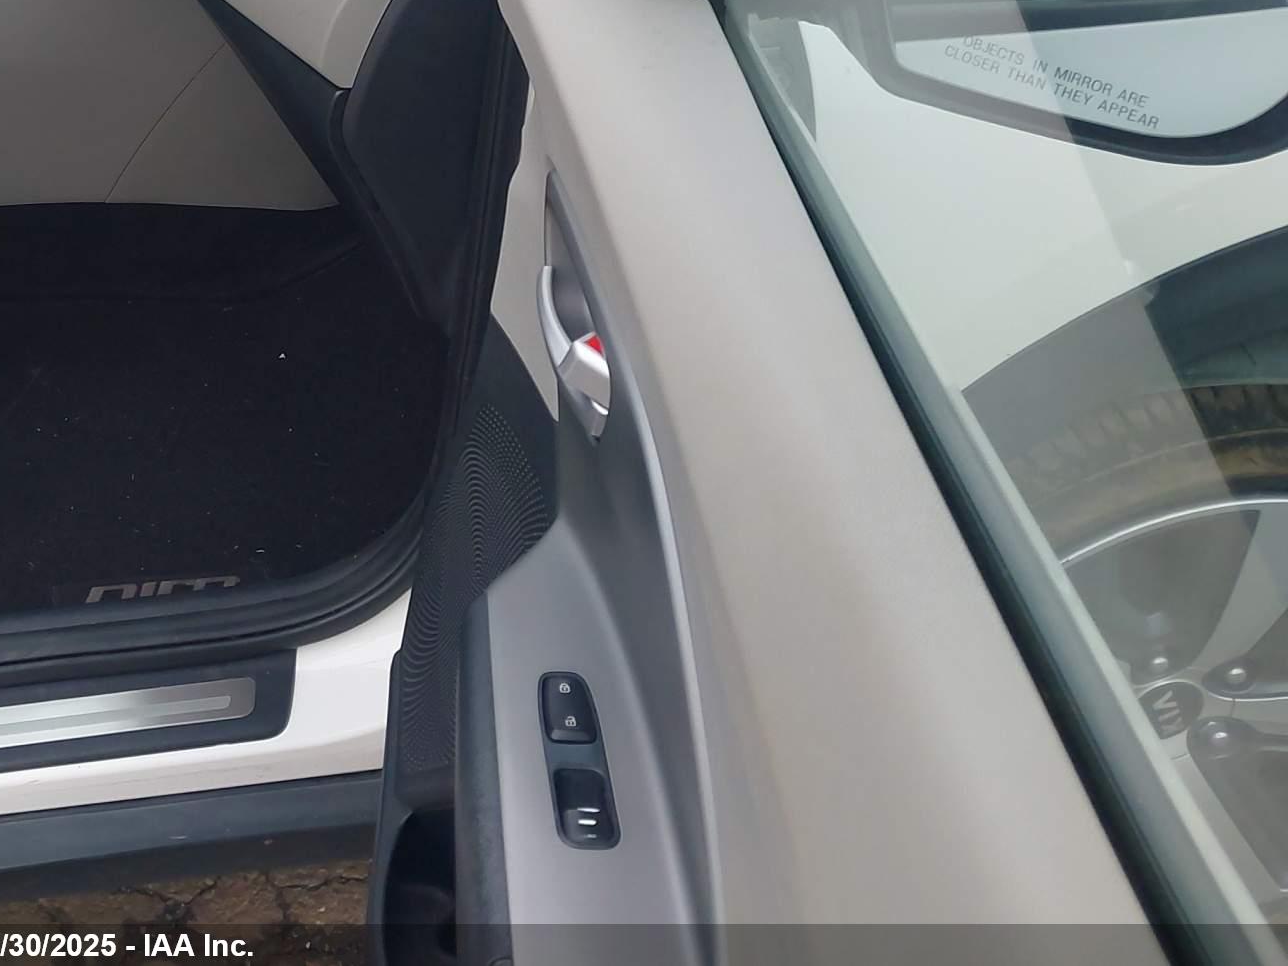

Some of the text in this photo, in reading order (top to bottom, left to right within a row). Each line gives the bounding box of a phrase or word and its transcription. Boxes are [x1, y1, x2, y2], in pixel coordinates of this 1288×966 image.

[944, 44, 1160, 130] CLOSER THAN THEY APPEAR
[962, 35, 1151, 108] OBJECTS IN MIRROR ARE
